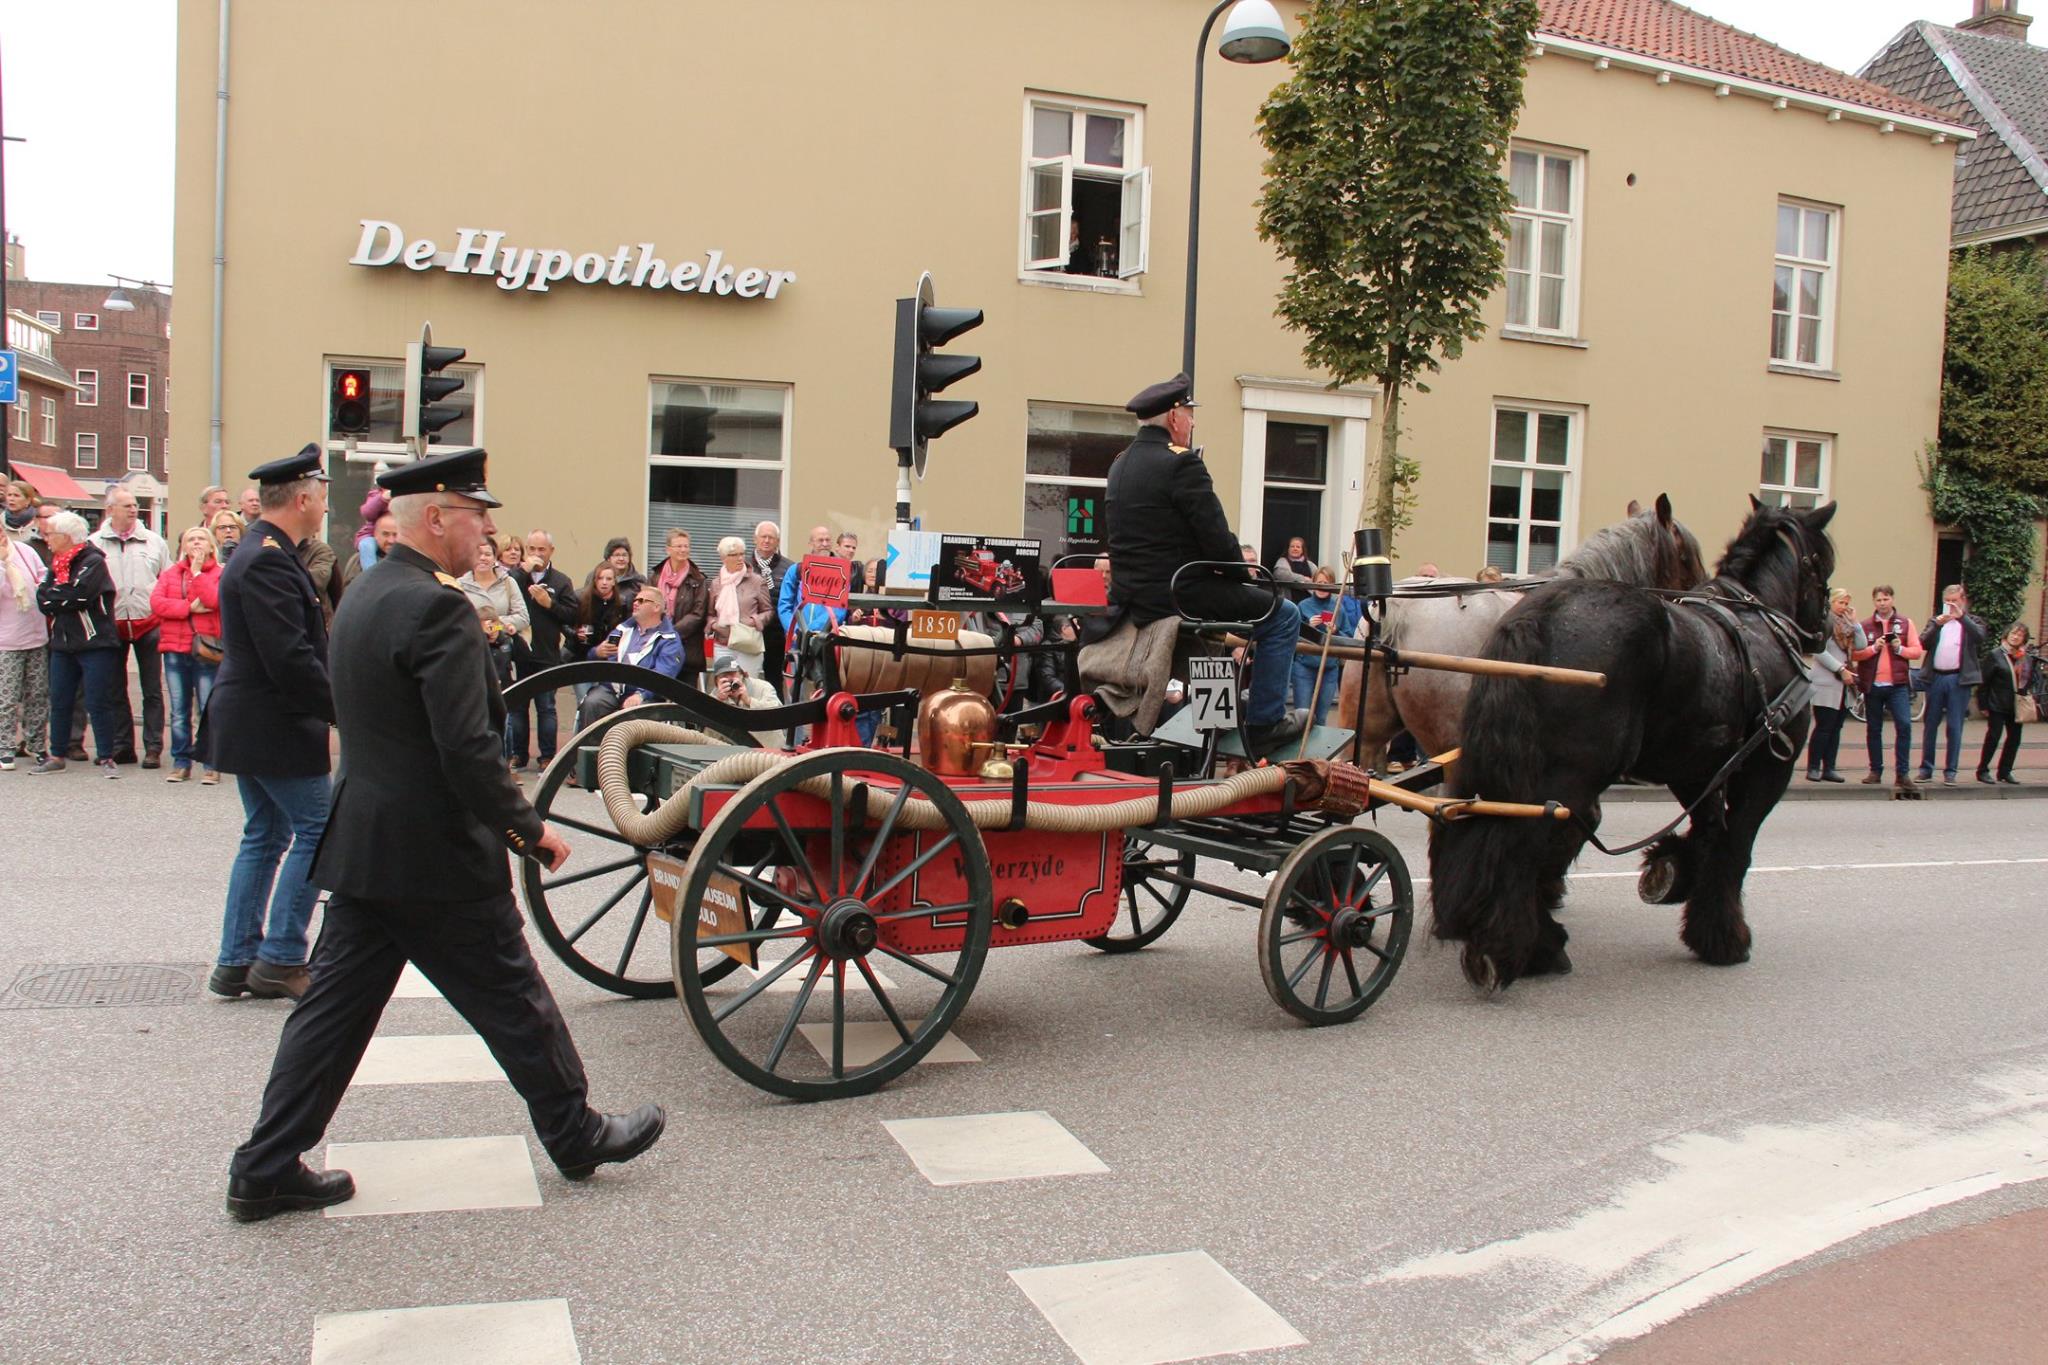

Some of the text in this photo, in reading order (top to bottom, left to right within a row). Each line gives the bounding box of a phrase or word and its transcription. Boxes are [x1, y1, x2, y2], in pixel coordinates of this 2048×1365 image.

[348, 218, 798, 301] De Hypotheker
[918, 615, 956, 634] 1850
[1191, 661, 1235, 679] MITRA
[1195, 686, 1234, 721] 74
